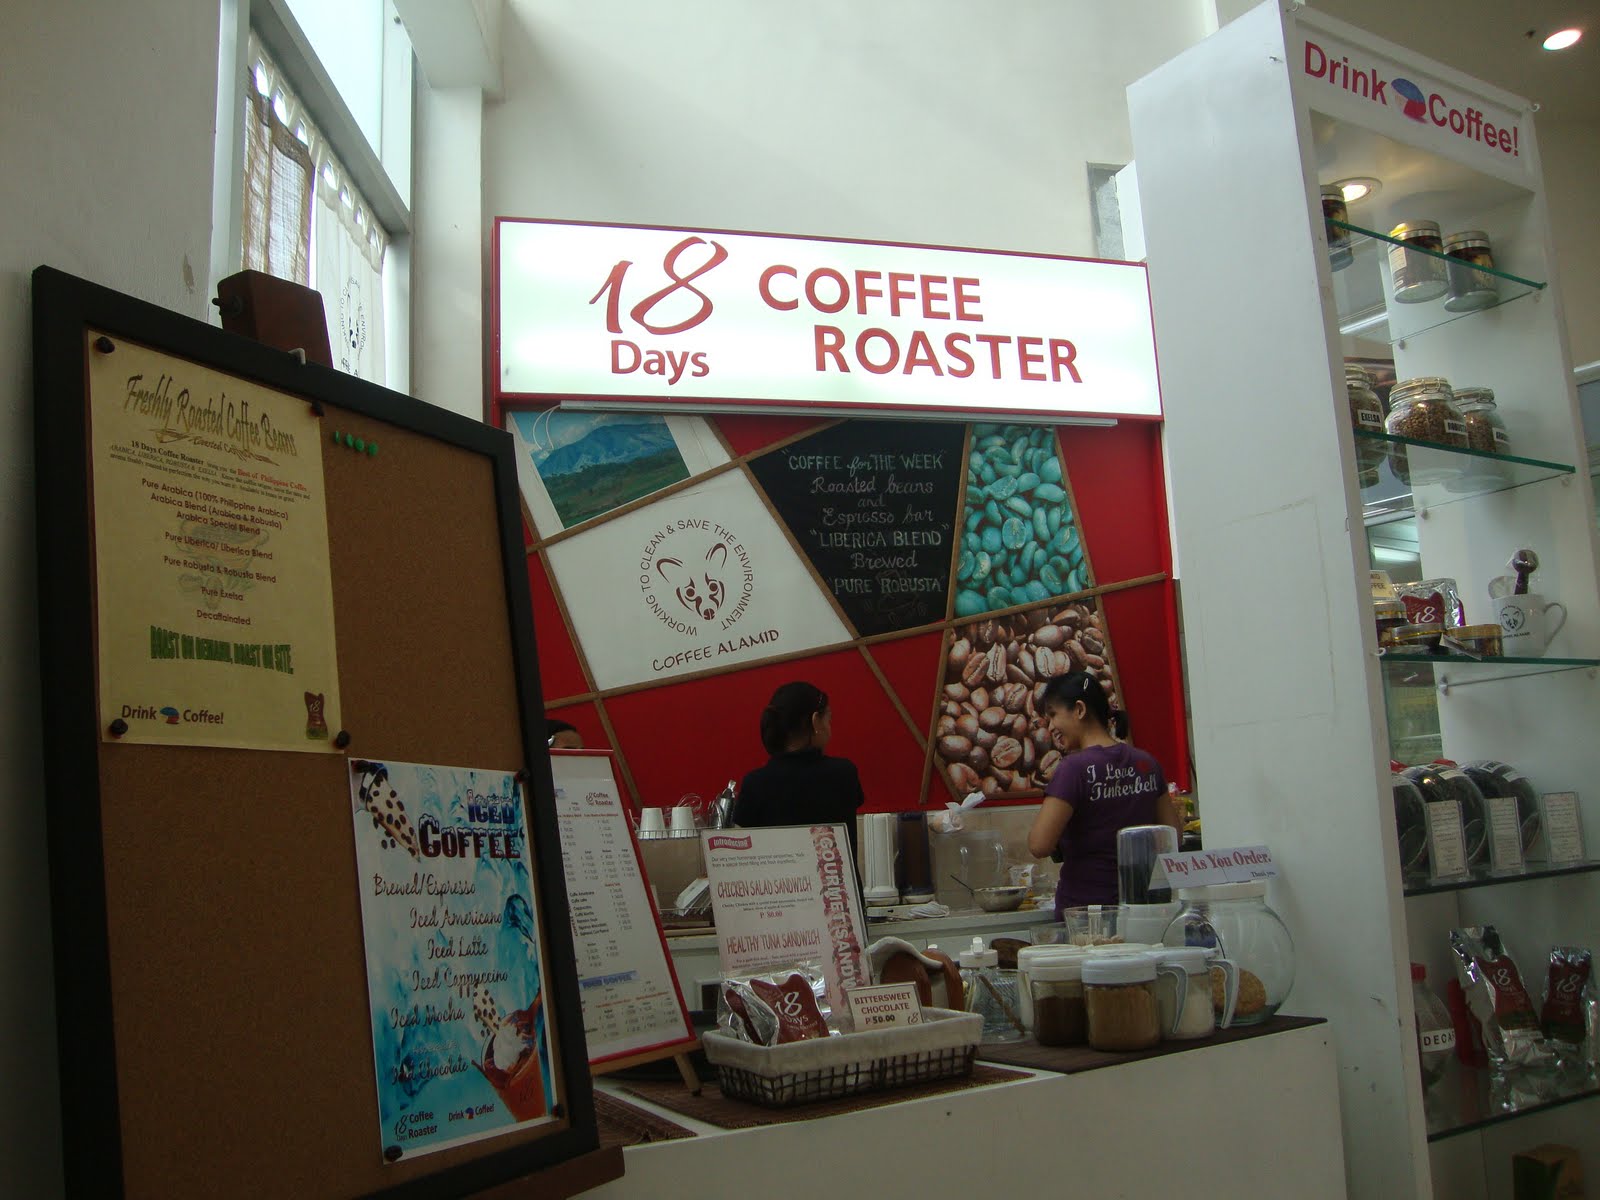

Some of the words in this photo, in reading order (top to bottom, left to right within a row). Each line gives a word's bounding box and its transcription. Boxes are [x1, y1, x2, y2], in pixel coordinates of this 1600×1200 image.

[1304, 40, 1387, 106] Drink
[1428, 93, 1519, 157] Coffee!
[588, 235, 729, 336] 18
[757, 263, 985, 324] COFFEE
[610, 338, 710, 386] Days
[812, 323, 1083, 385] ROASTER
[123, 374, 173, 428] Freshly
[177, 388, 226, 437] Roasted
[226, 400, 261, 451] Coffee
[261, 412, 298, 457] Beans
[1361, 411, 1381, 424] EXELSA
[131, 440, 140, 448] 18
[141, 443, 157, 453] Days
[158, 447, 179, 460] Coffee
[180, 453, 204, 465] Roaster
[871, 453, 896, 471] THE
[810, 476, 876, 494] Roasted
[885, 473, 934, 494] beans
[141, 478, 159, 490] Pure
[161, 483, 194, 498] Arabica
[194, 490, 219, 503] (100%
[220, 496, 255, 512] Philippine
[257, 506, 289, 520] Arabica)
[857, 496, 886, 508] and
[150, 492, 183, 507] Arabica
[184, 500, 207, 513] Blend
[208, 506, 241, 520] (Arabica
[250, 515, 282, 530] Robusta)
[902, 504, 934, 524] bar
[176, 511, 208, 525] Arabica
[210, 517, 238, 532] Special
[239, 523, 261, 536] Blend
[666, 524, 676, 535] &
[677, 519, 710, 531] SAVE
[714, 523, 737, 546] THE
[165, 531, 183, 543] Pure
[220, 542, 250, 556] Liberica
[251, 548, 273, 560] Blend
[640, 531, 666, 571] CLEAN
[164, 555, 181, 567] Pure
[183, 559, 215, 573] Robusta
[224, 566, 254, 580] Robusta
[255, 572, 277, 583] Blend
[850, 550, 918, 569] Brewed
[201, 586, 219, 597] Pure
[639, 574, 650, 592] TO
[720, 544, 754, 631] ENVIRONMENT
[645, 594, 698, 637] WORKING
[1412, 606, 1437, 624] 18
[652, 645, 712, 672] COFFEE
[717, 629, 780, 655] ALAMID
[121, 704, 157, 720] Drink
[183, 709, 224, 725] Coffee!
[1105, 763, 1136, 780] Love
[1089, 773, 1158, 802] Tinkerbell
[466, 789, 515, 824] ICED
[418, 812, 521, 859] COFFEE
[1163, 857, 1189, 876] Pay
[1191, 855, 1208, 872] As
[1206, 852, 1233, 869] You
[717, 879, 750, 898] CHICKEN
[750, 879, 773, 897] SALAD
[774, 876, 813, 895] SANDWICH
[819, 837, 848, 924] GOURMET
[410, 904, 440, 929] Iced
[440, 905, 503, 929] Americano
[427, 938, 455, 960] Iced
[457, 935, 489, 957] Latte
[726, 934, 759, 955] HEALTHY
[760, 933, 781, 951] TUNA
[781, 928, 821, 948] SANDWICH
[412, 969, 441, 992] Iced
[1492, 968, 1511, 986] 18
[1556, 973, 1581, 993] 18
[775, 991, 803, 1017] 18
[854, 991, 912, 1005] BITTERSWEET
[861, 1001, 910, 1014] CHOCOLATE
[391, 1005, 421, 1030] Iced
[784, 1014, 809, 1025] Days
[872, 1014, 896, 1024] 50.00
[907, 1012, 920, 1025] 18
[409, 1110, 434, 1124] Coffee
[448, 1110, 465, 1122] Drink
[408, 1124, 438, 1139] Roaster
